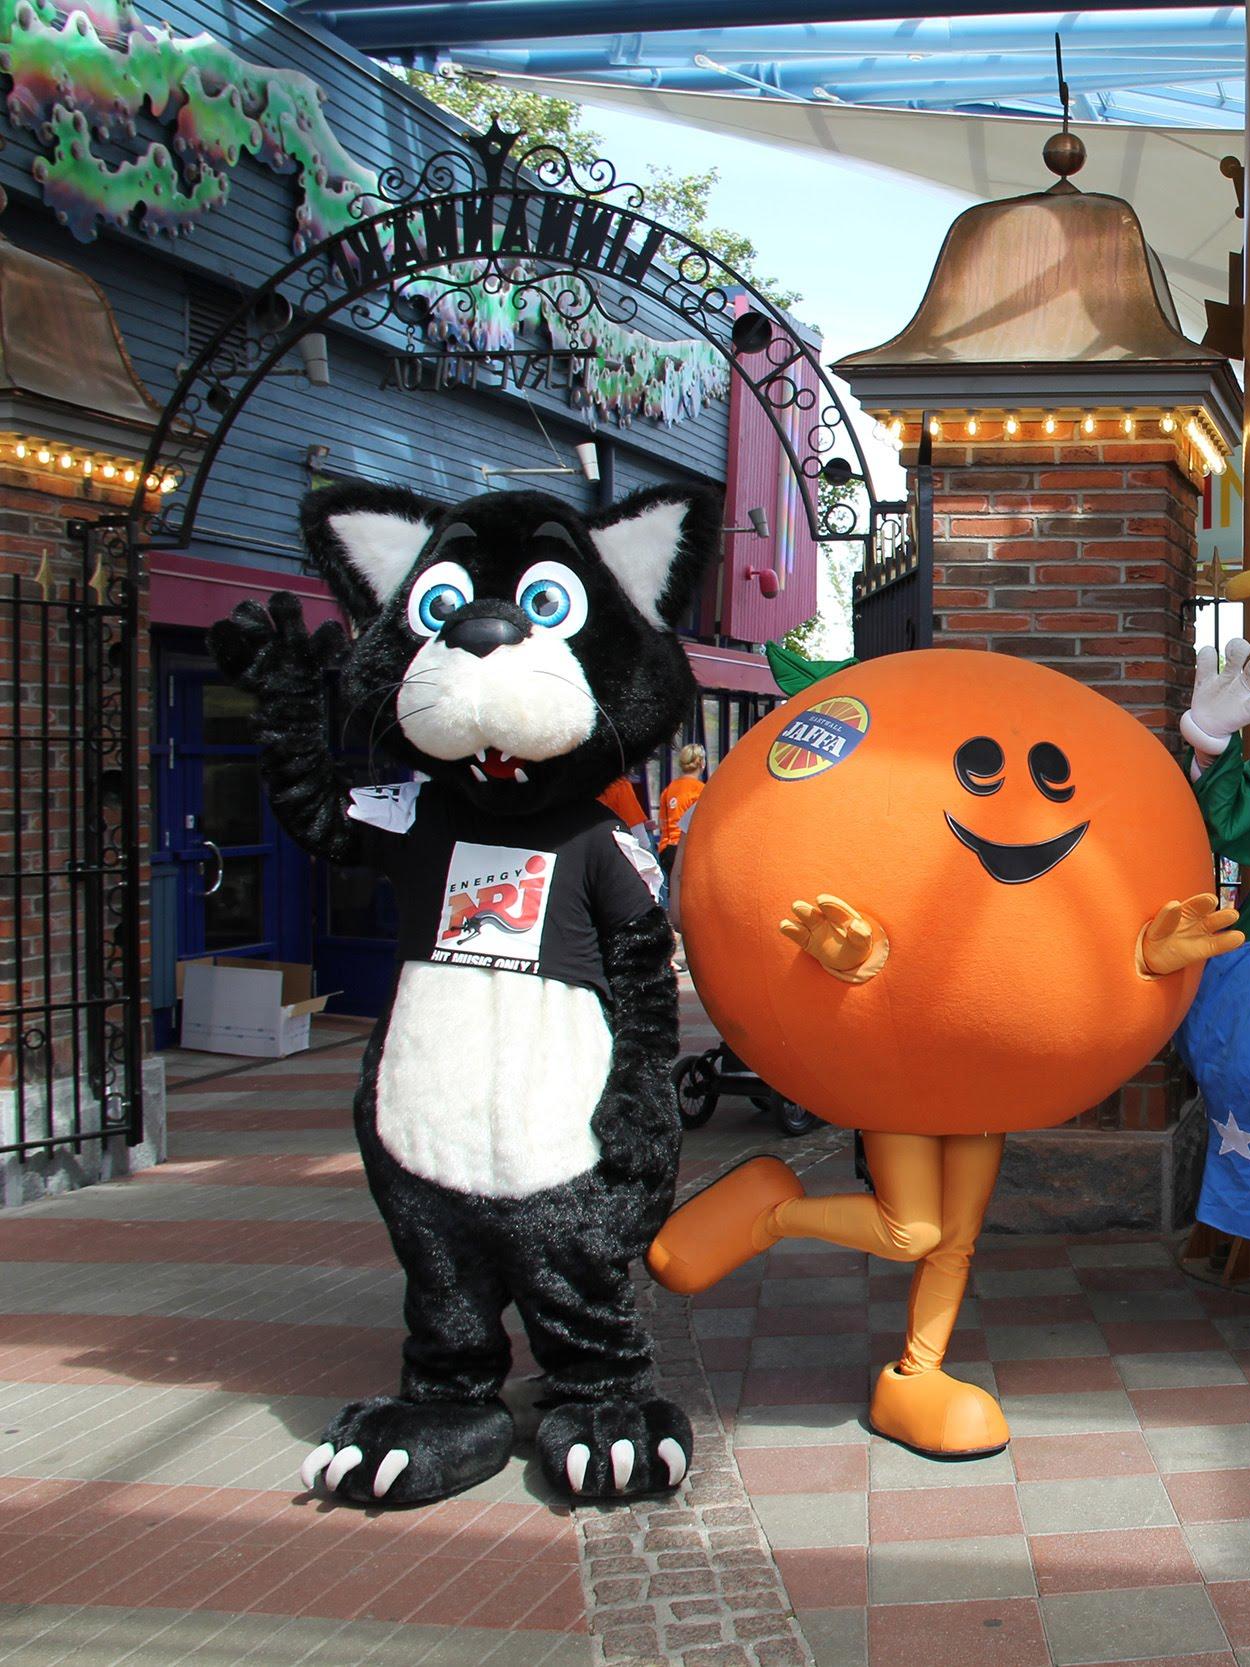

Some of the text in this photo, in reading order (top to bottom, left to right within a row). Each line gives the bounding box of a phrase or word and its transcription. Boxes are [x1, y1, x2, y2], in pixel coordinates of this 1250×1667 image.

[781, 721, 847, 757] JAFFA
[449, 869, 523, 893] ENERGY
[430, 949, 452, 962] HIT
[451, 952, 493, 967] MUSIC
